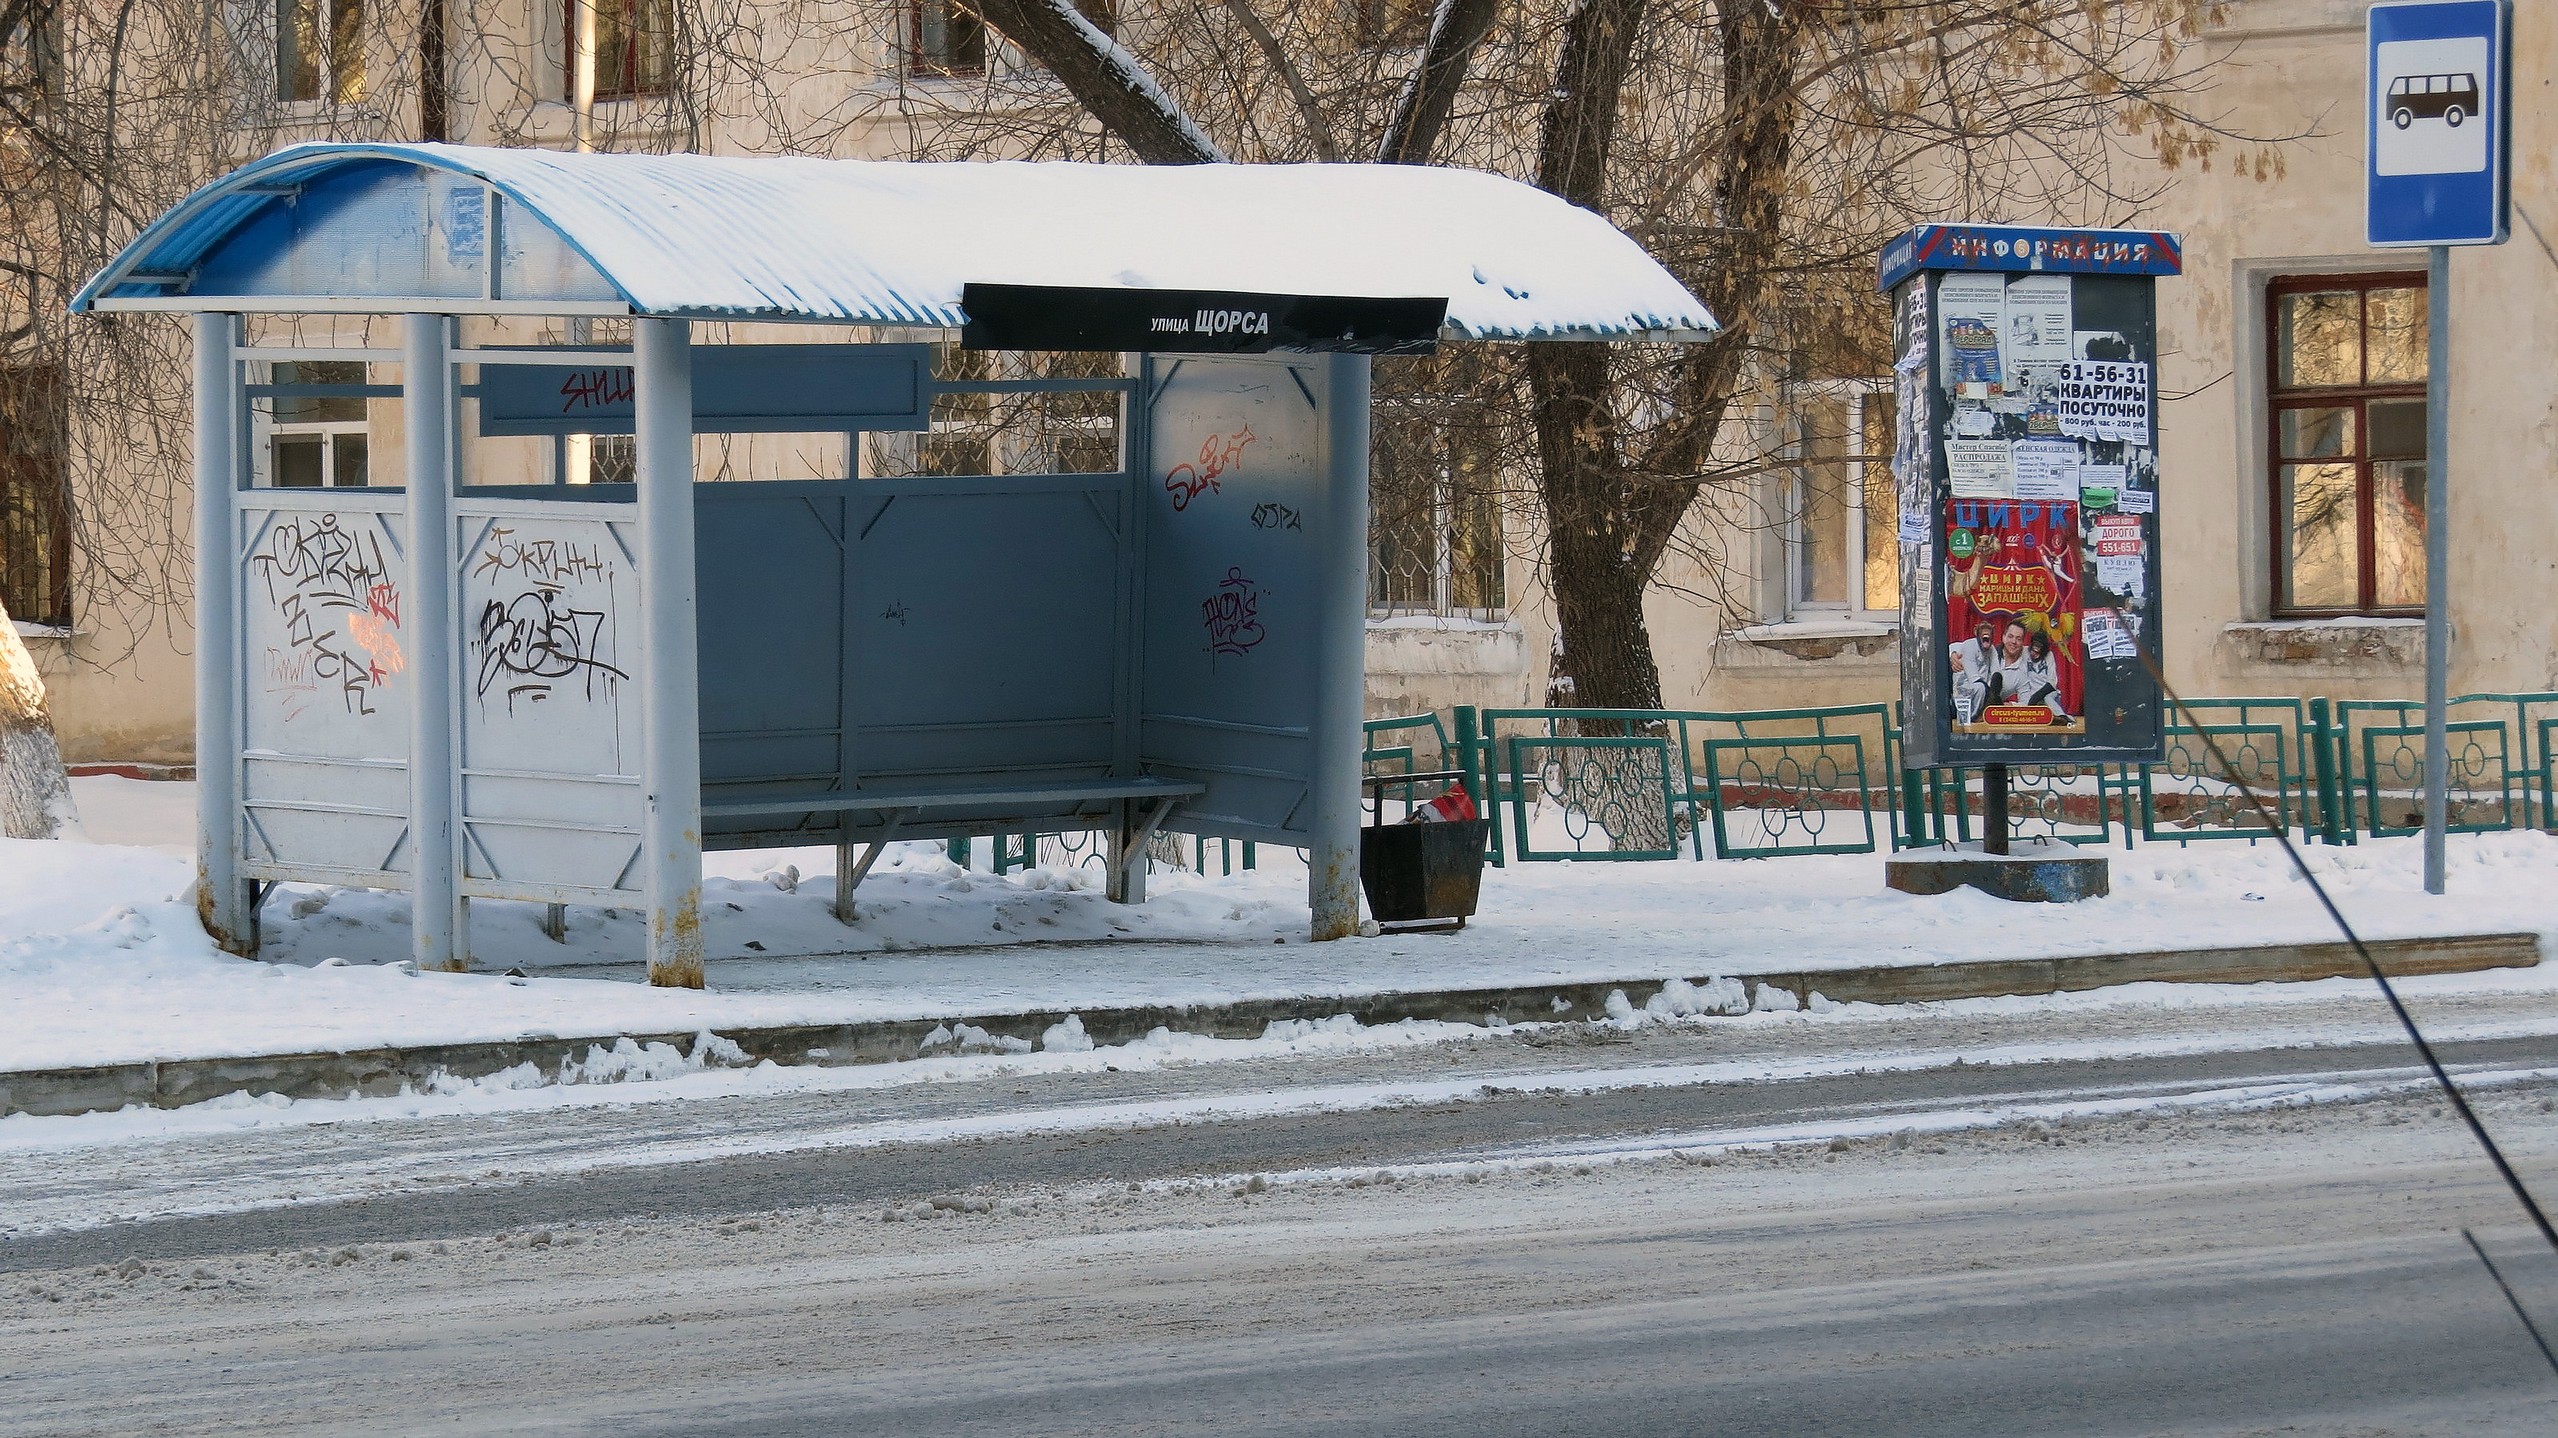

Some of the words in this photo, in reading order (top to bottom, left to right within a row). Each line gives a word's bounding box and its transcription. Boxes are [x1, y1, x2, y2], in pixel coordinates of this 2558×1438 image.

[1151, 318, 1189, 334] УЛИЦА
[1195, 309, 1269, 337] ЩОРСА
[2060, 363, 2146, 384] 61-56-31
[2060, 383, 2146, 402] КВАРТИРЫ
[2060, 401, 2146, 418] ПОСУТОЧНО
[2081, 418, 2096, 427] руб.
[2133, 421, 2146, 429] руб.
[1953, 453, 2006, 461] РАСПРОДАЖА
[1956, 500, 2069, 529] ЦИРК
[1961, 533, 1968, 545] 1
[2102, 528, 2135, 539] ДОРОГО
[2102, 543, 2137, 552] 551-651
[1989, 574, 2035, 584] ЦИРК
[1978, 592, 2049, 608] ЗАПАШНЫХ
